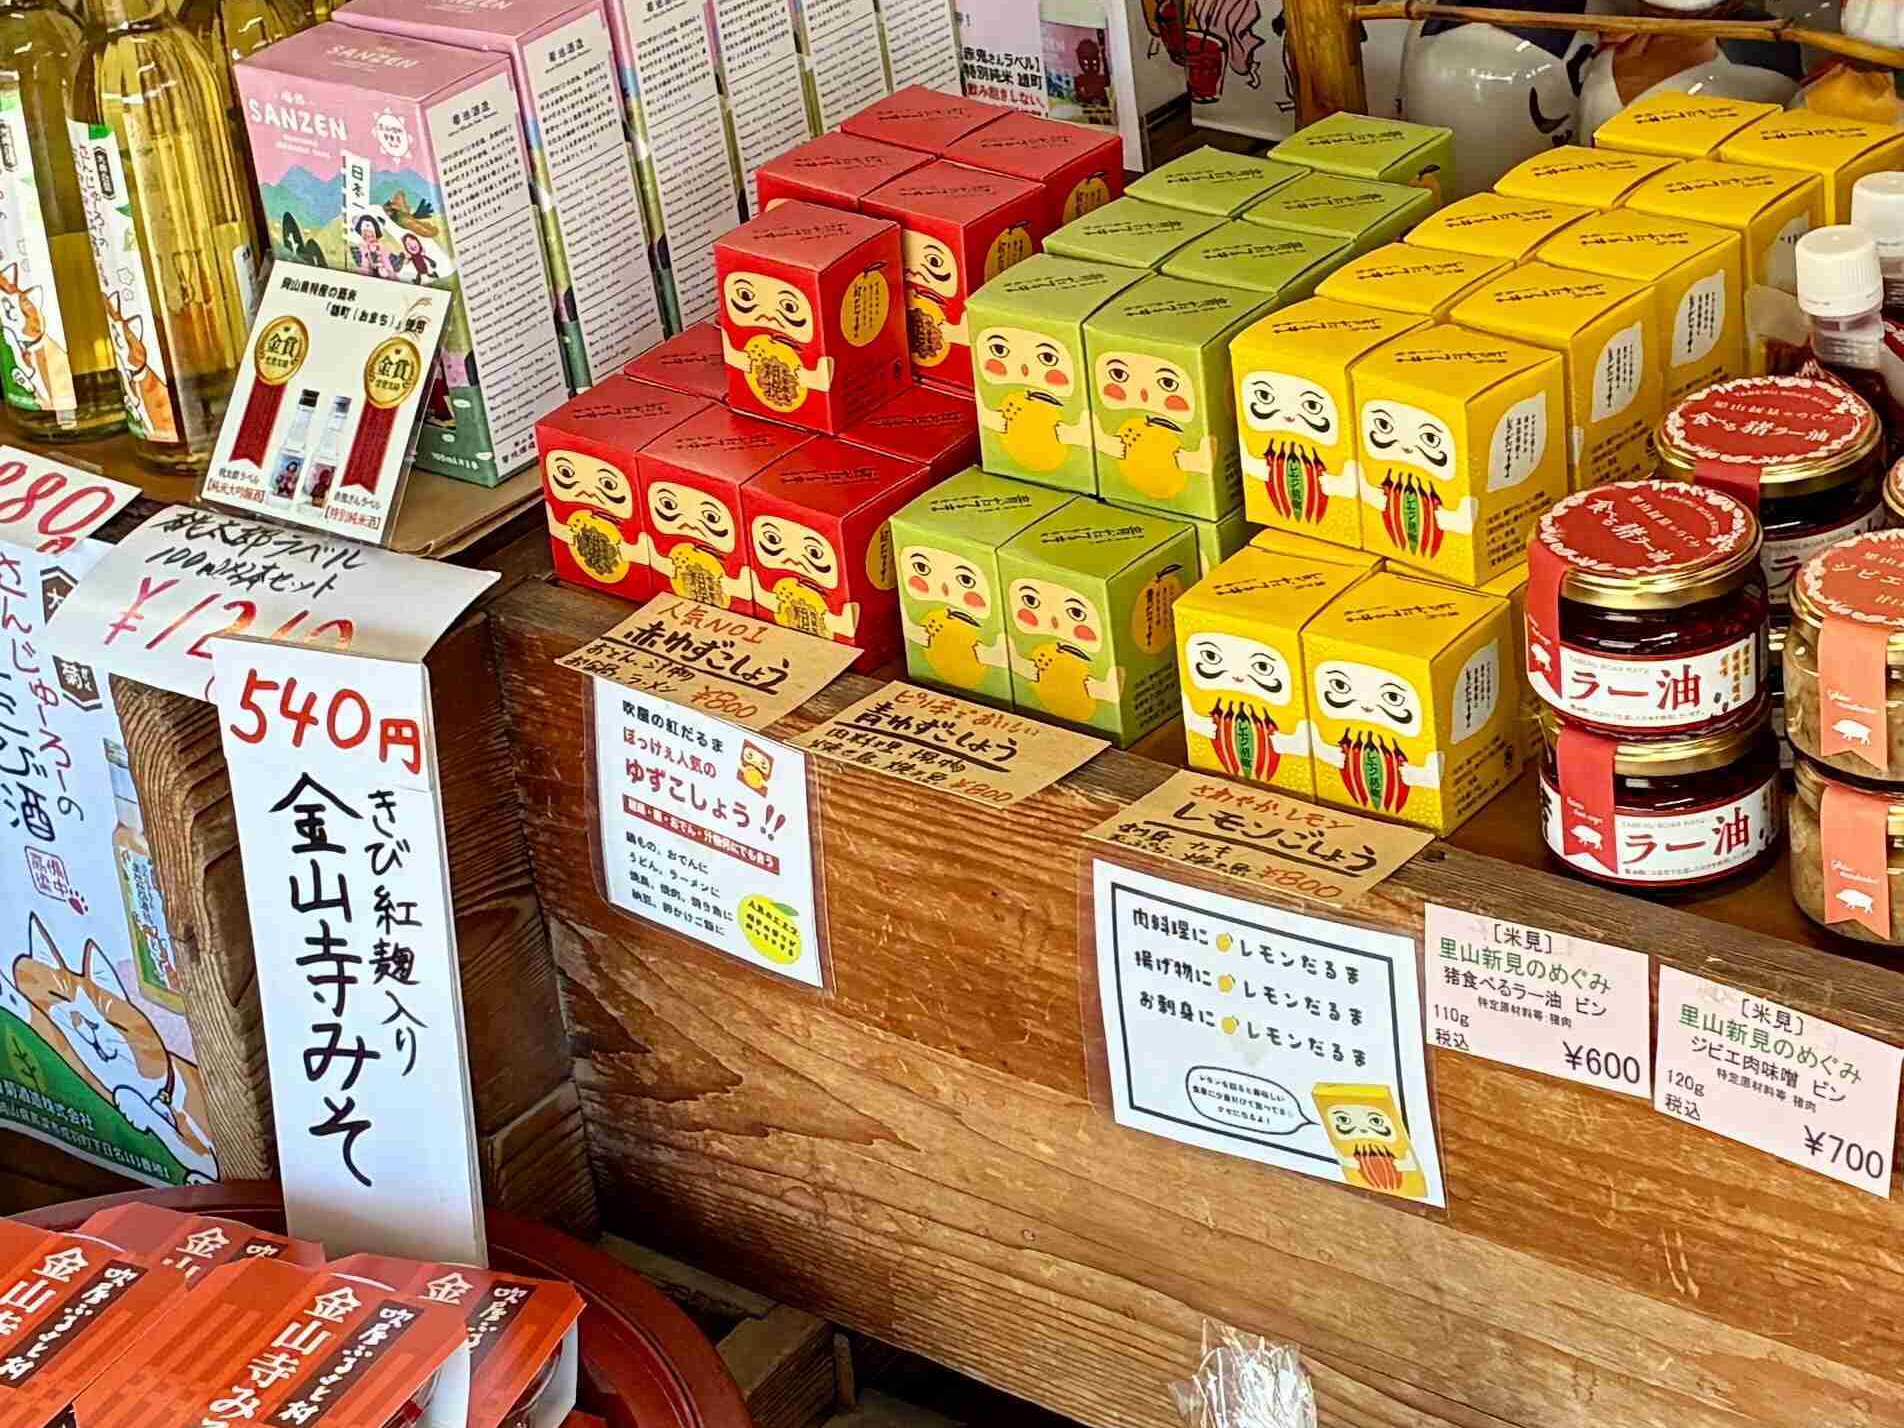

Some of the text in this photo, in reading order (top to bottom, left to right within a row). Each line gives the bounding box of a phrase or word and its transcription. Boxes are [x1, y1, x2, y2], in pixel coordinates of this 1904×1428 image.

[248, 97, 348, 142] SANZEN
[1569, 663, 1702, 712] ラー油
[230, 667, 423, 774] 540円
[621, 699, 724, 754] 吹屋の紅だるま
[1173, 801, 1378, 871] レモンごしょう
[1623, 806, 1751, 865] ラー油
[1132, 907, 1361, 984] 肉料理に レモンだるま
[1438, 937, 1611, 995] 里山新見のめぐみ
[271, 772, 384, 1187] 金山寺みそ
[1134, 951, 1364, 1027] 揚げ物に レモンだるま
[1443, 965, 1609, 1018] 猪食べるラー油 ビン
[1139, 991, 1368, 1068] お刺身に レモンだるま
[1433, 1003, 1471, 1029] 110g
[1434, 1028, 1471, 1051] 税込
[1678, 1003, 1864, 1084] 里山新見のめぐみ
[1562, 1041, 1641, 1085] ¥600
[1665, 1069, 1706, 1097] 120g
[1689, 1035, 1847, 1103] ジビエ肉味噌 ビン
[1664, 1094, 1702, 1122] 税込
[1802, 1124, 1885, 1180] ¥700
